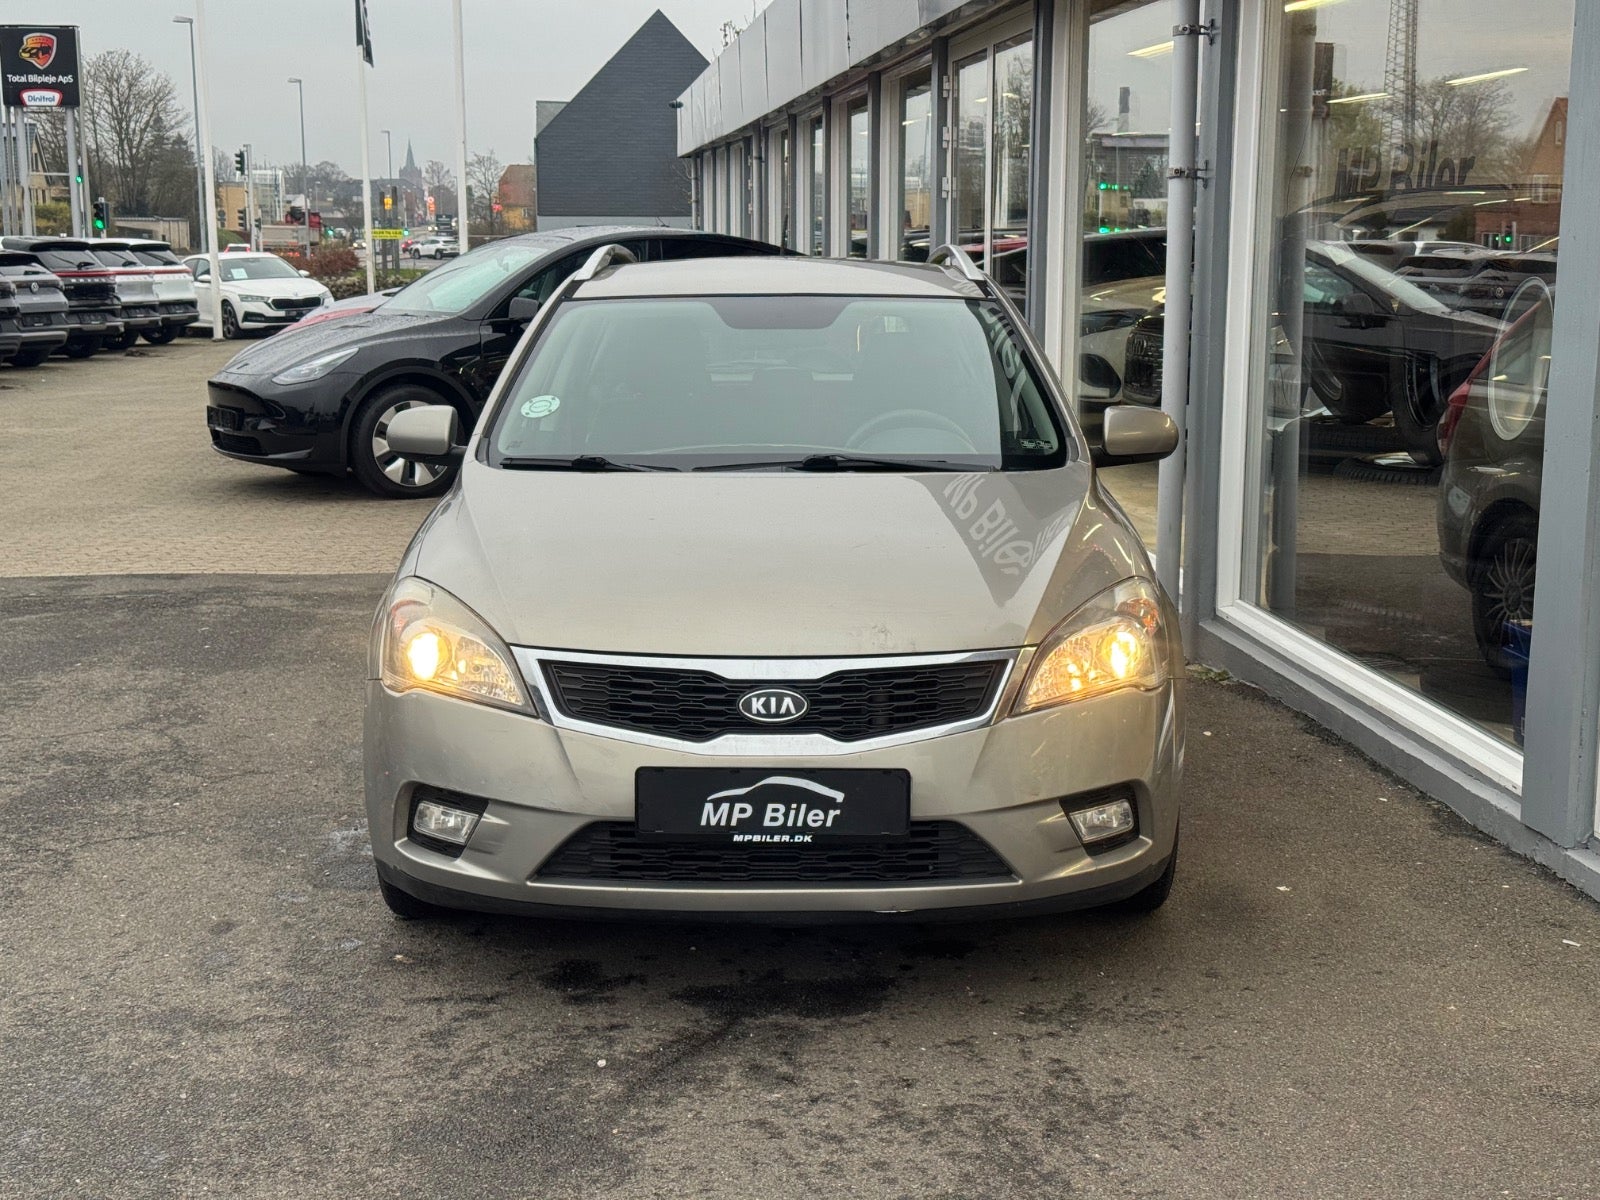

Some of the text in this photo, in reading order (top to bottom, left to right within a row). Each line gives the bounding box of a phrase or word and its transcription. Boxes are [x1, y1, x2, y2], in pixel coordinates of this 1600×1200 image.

[6, 74, 74, 84] Total Bilpleje ApS
[751, 697, 797, 714] KIA
[700, 803, 841, 827] MP Biler
[733, 834, 813, 843] MPBILER.DK
